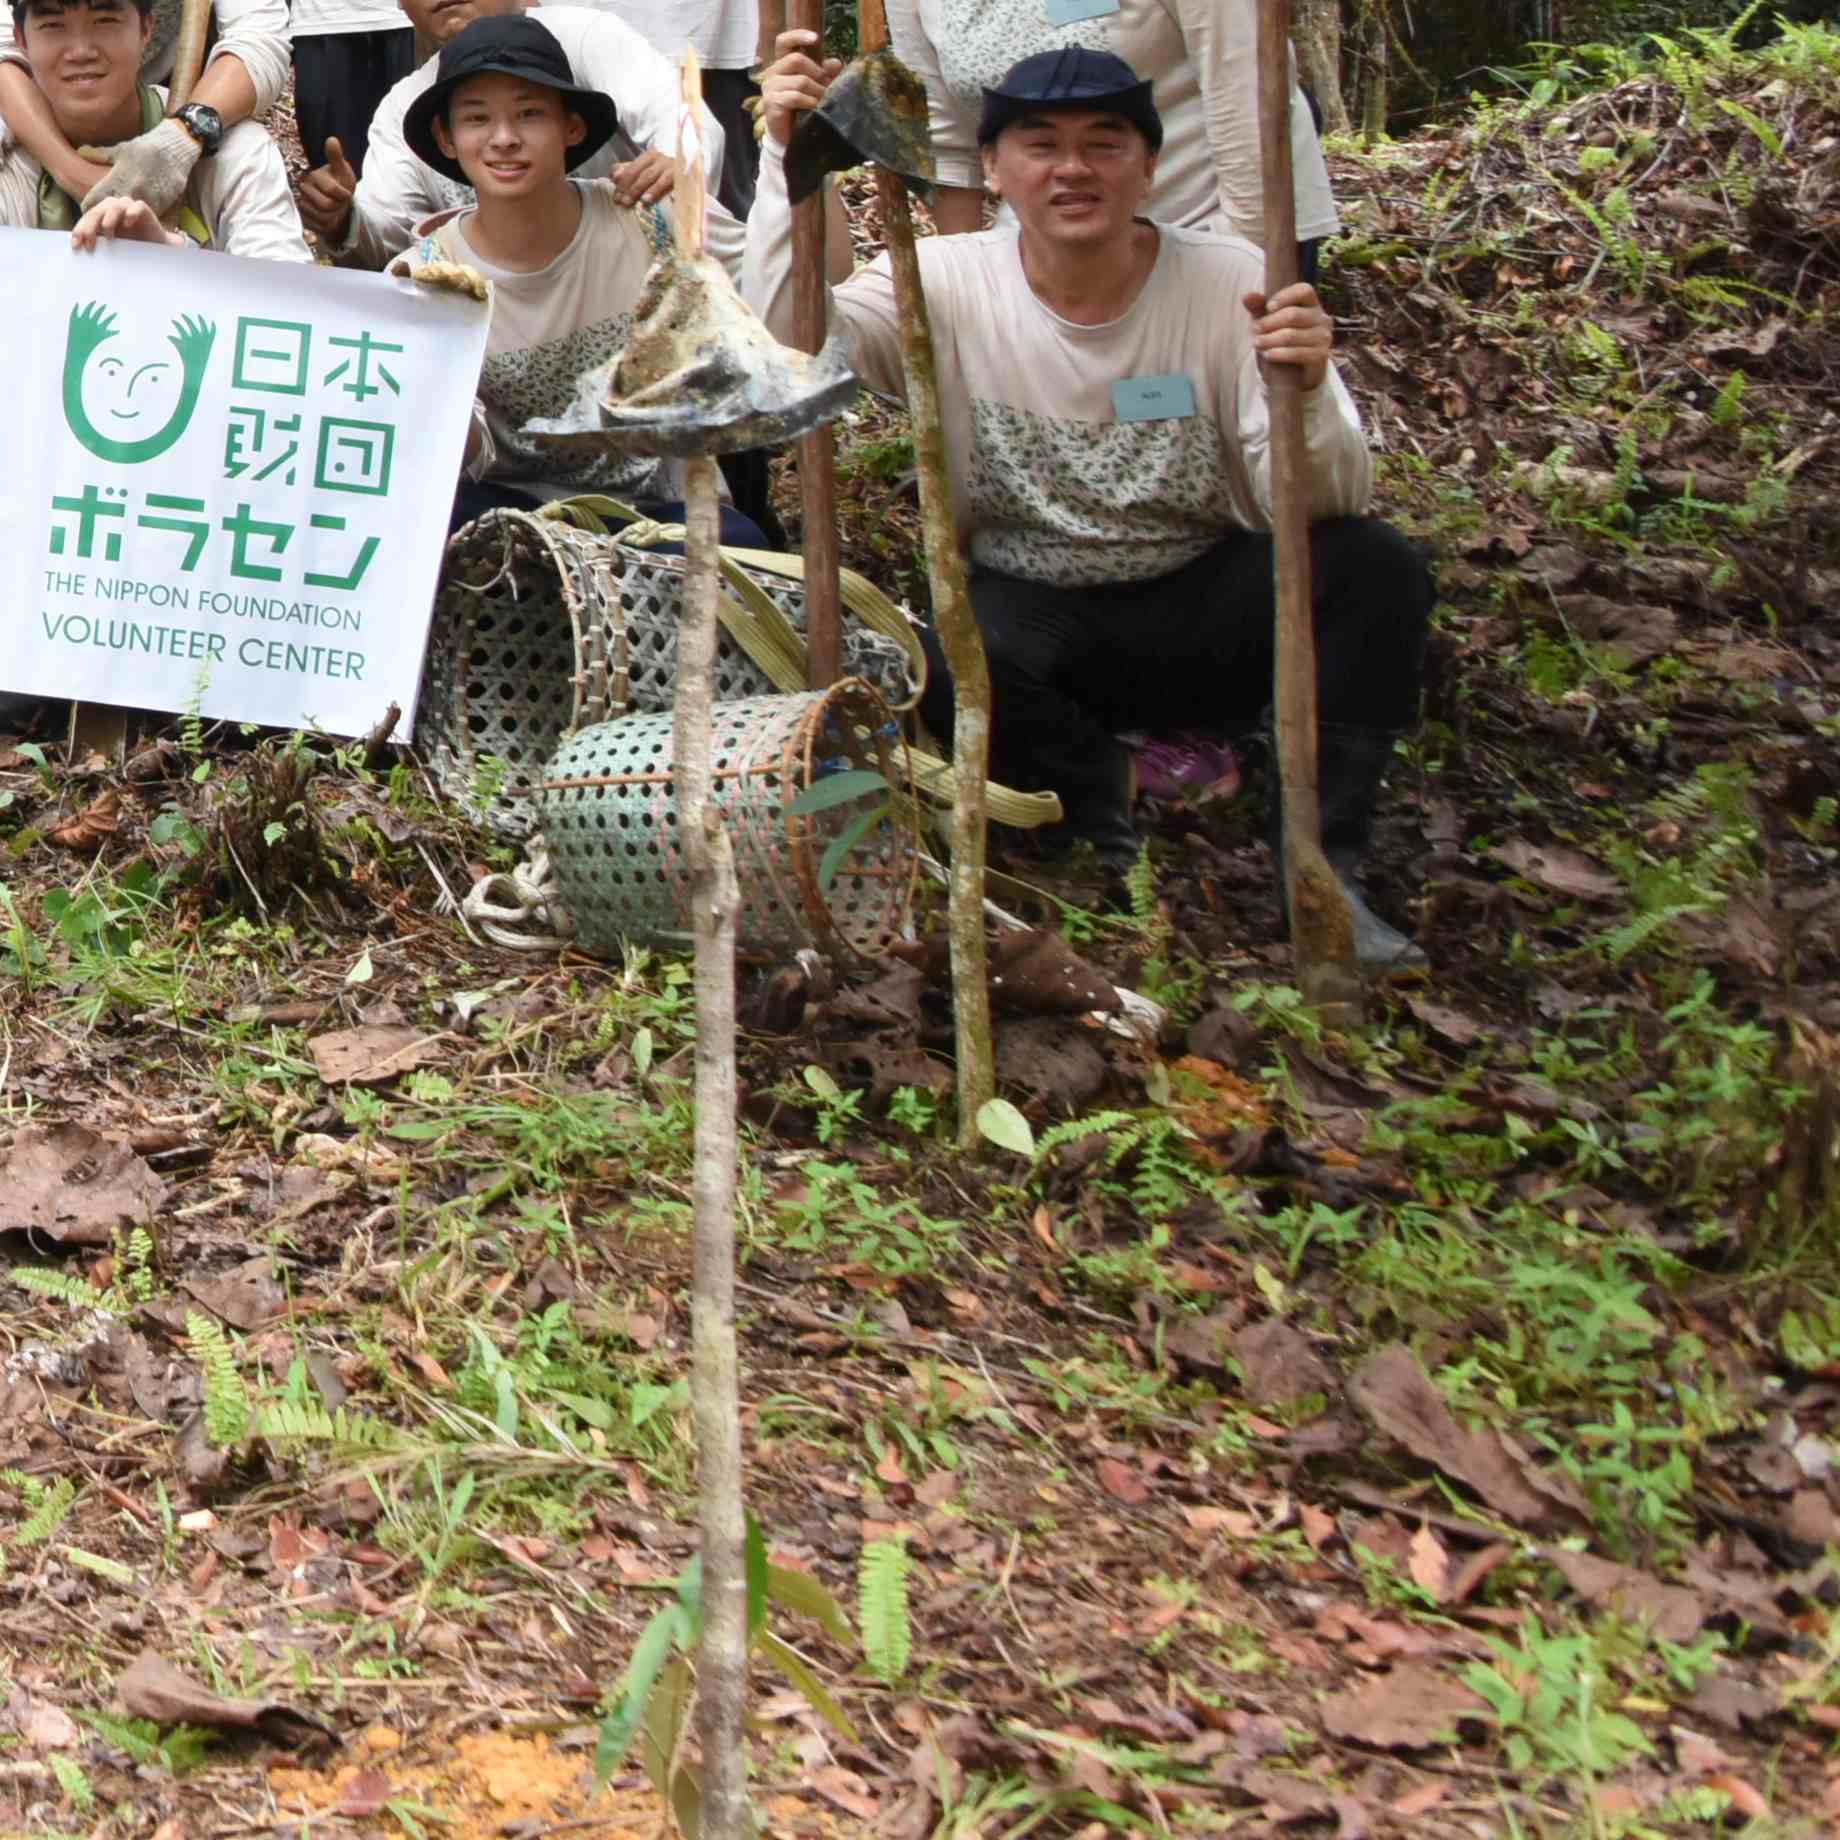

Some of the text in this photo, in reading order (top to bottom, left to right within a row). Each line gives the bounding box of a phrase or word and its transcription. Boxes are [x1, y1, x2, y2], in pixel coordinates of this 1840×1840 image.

[231, 315, 404, 403] 日本
[222, 405, 396, 497] 財団
[49, 484, 382, 591] ボラセン
[44, 571, 363, 632] THE NIPPON FOUNDATION
[41, 611, 366, 681] VOLUNTEER CENTER
